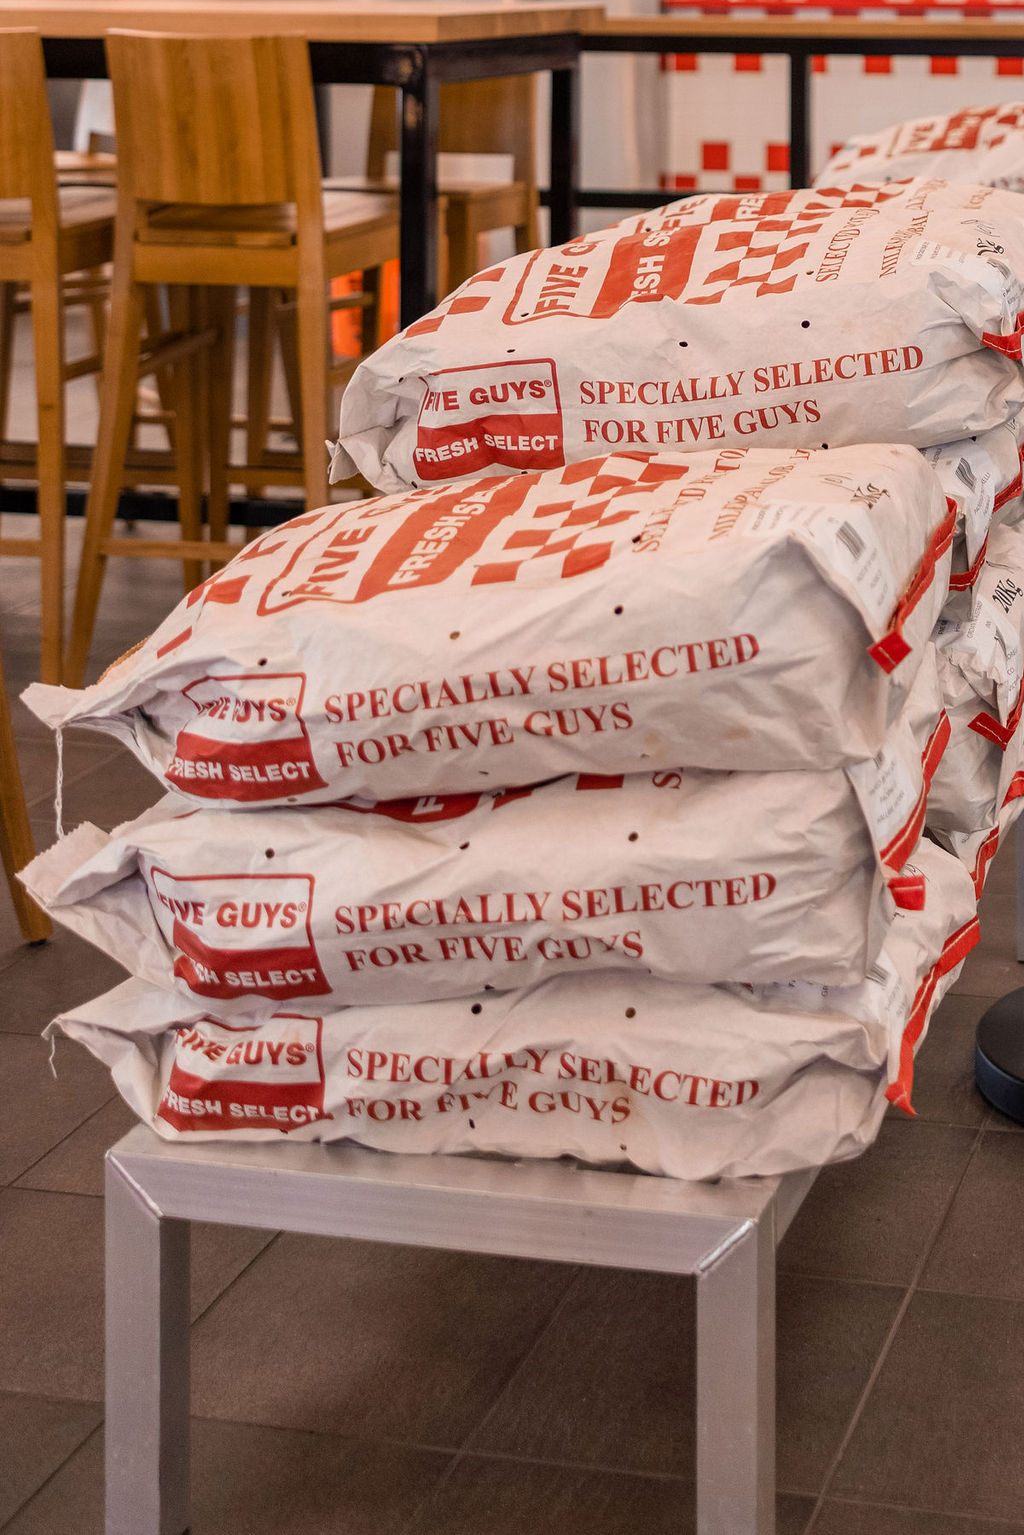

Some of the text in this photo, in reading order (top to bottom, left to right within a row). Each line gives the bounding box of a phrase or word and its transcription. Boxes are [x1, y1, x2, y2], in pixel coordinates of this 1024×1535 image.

[533, 263, 589, 315] FIVE
[579, 344, 924, 405] SPECIALLY SELECTED
[583, 399, 821, 444] FOR FIVE GUYS
[415, 432, 559, 463] FRESH SELECT
[289, 524, 378, 597] FIVE
[387, 510, 463, 585] FRESH
[991, 578, 1024, 614] 20Kg
[323, 633, 760, 725] SPECIALLY SELECTED
[333, 701, 634, 769] FOR FIVE GUYS
[227, 760, 312, 782] SELECT
[335, 870, 778, 935] SPECIALLY SELECTED
[343, 929, 645, 972] FOR FIVE GUYS
[224, 967, 318, 987] SELECT
[345, 1048, 760, 1109] SPECIALLY SELECTED
[228, 1102, 318, 1123] SELECT
[343, 1095, 425, 1122] FOR
[528, 1089, 633, 1125] GUYS
